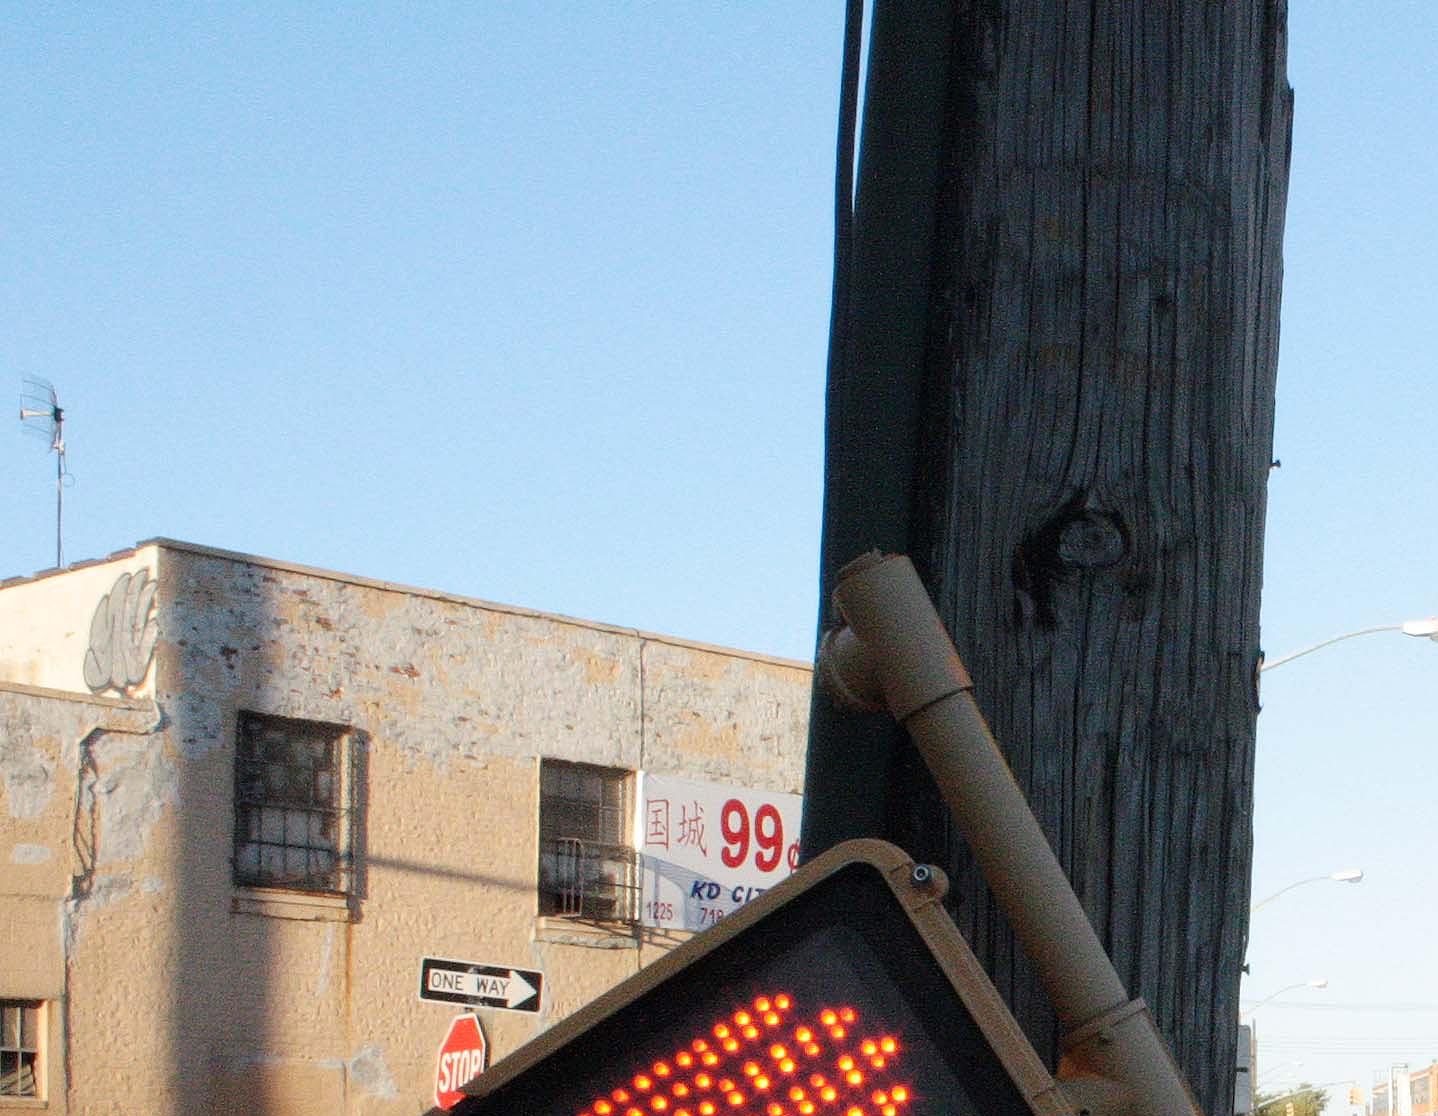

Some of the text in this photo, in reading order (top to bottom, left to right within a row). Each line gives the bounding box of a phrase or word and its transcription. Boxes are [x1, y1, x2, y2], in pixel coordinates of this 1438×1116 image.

[645, 799, 708, 857] 国城
[691, 880, 721, 900] KD
[646, 902, 673, 921] 1225
[431, 972, 510, 996] ONE WAY
[438, 1049, 481, 1093] STOP
